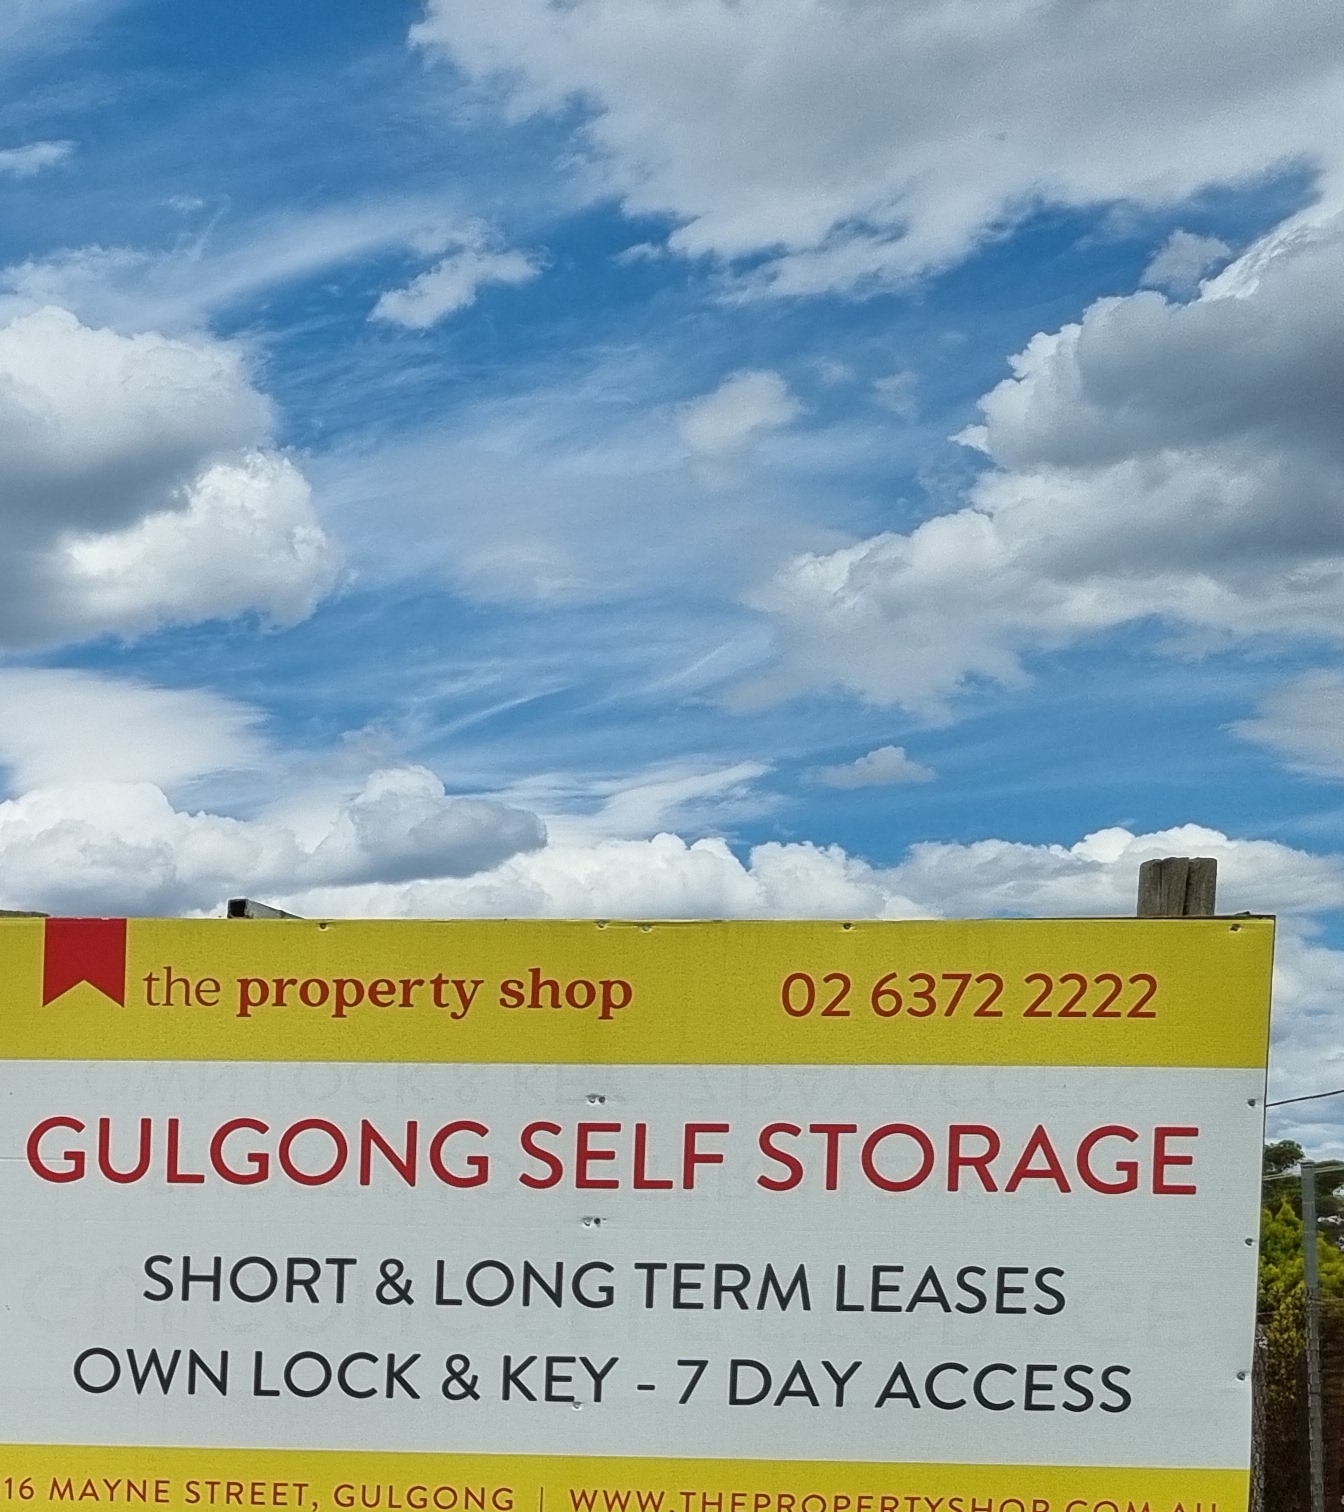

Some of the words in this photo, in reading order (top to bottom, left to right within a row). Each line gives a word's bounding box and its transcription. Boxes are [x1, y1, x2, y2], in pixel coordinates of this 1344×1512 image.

[143, 966, 220, 1006] the
[236, 972, 484, 1019] property
[500, 968, 632, 1020] shop
[782, 973, 851, 1017] 02
[872, 972, 1003, 1017] 6372
[1023, 973, 1157, 1018] 2222
[28, 1117, 488, 1187] GULGONG
[520, 1121, 730, 1189] SELF
[759, 1122, 1199, 1195] STORAGE
[143, 1255, 358, 1304] SHORT
[375, 1259, 415, 1306] &
[435, 1260, 615, 1309] LONG
[635, 1263, 811, 1312] TERM
[835, 1265, 1066, 1316] LEASES
[73, 1348, 229, 1397] OWN
[253, 1350, 422, 1400] LOCK
[441, 1353, 481, 1401] &
[502, 1355, 620, 1404] KEY
[677, 1359, 709, 1405] 7
[728, 1360, 863, 1408] DAY
[875, 1362, 1132, 1413] ACCESS
[49, 1478, 170, 1503] MAYNE
[184, 1481, 319, 1512] STREET,
[333, 1484, 514, 1511] GULGONG
